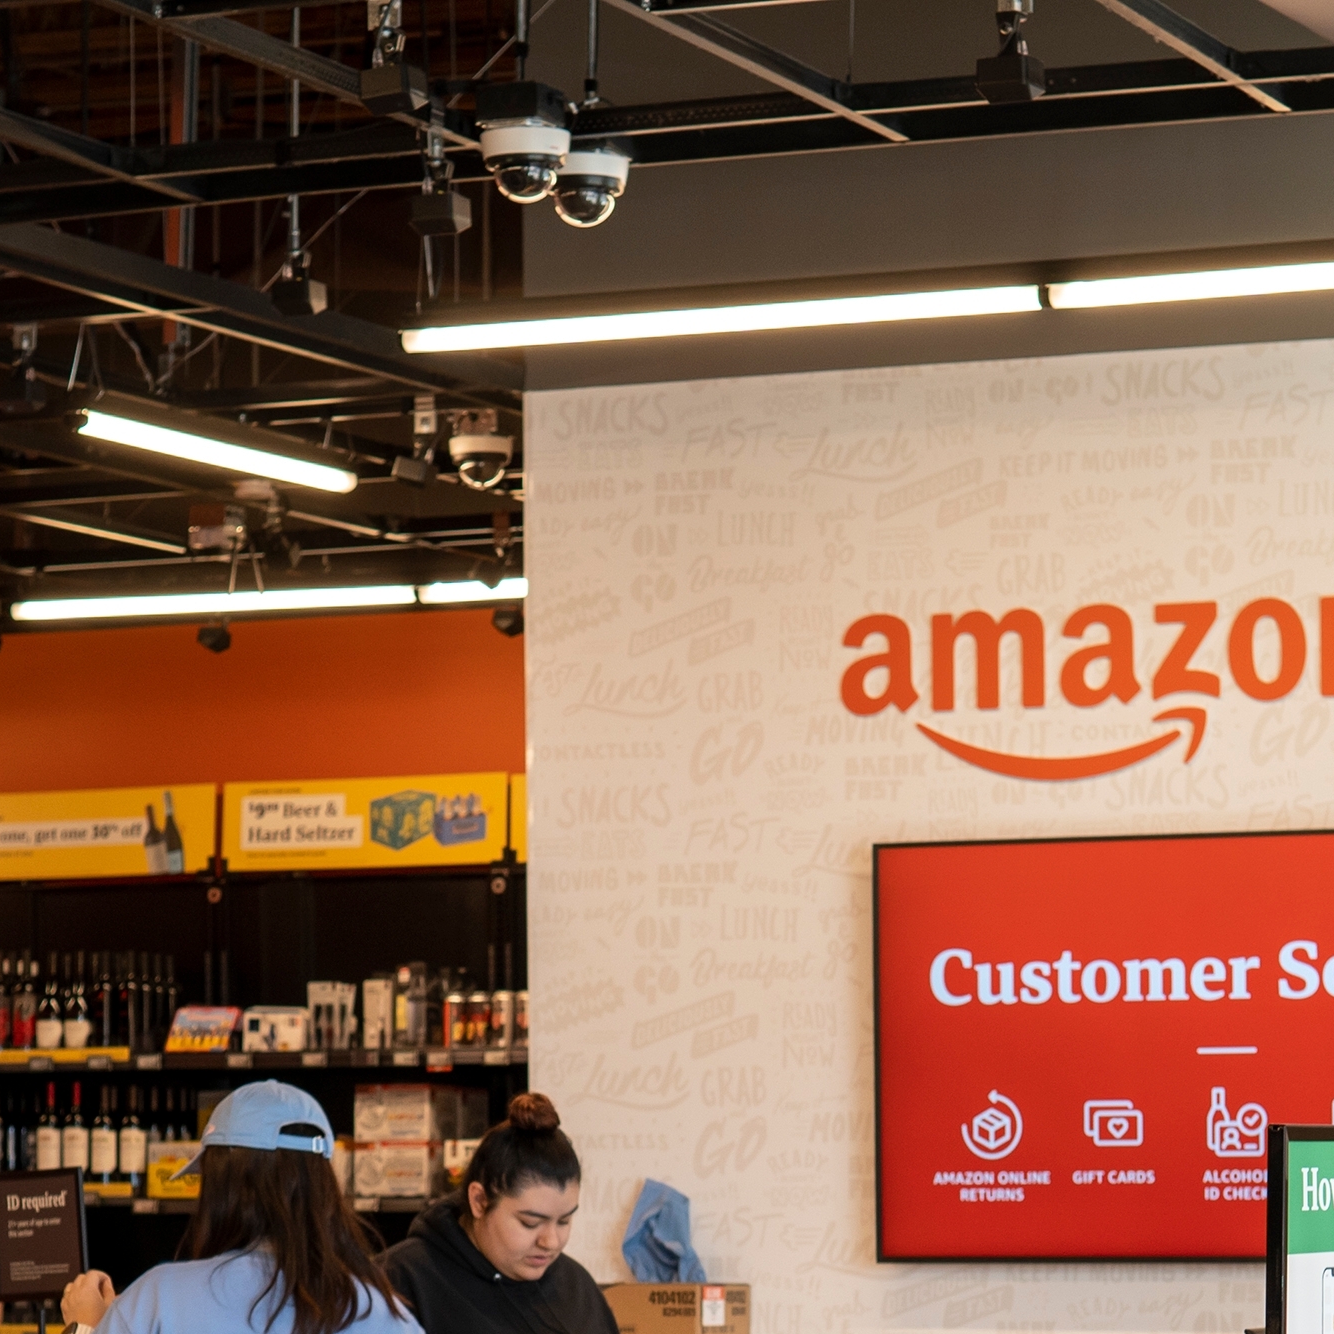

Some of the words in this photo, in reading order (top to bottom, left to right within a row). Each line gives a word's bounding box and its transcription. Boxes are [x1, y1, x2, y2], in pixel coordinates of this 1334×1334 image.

[929, 948, 1260, 1006] Customer
[934, 1171, 994, 1186] AMAZON
[998, 1171, 1051, 1185] ONLINE
[1072, 1171, 1104, 1184] GIFT
[1108, 1170, 1155, 1184] CARDS
[960, 1188, 1024, 1202] RETURNS
[1204, 1186, 1219, 1200] ID
[7, 1194, 20, 1211] ID
